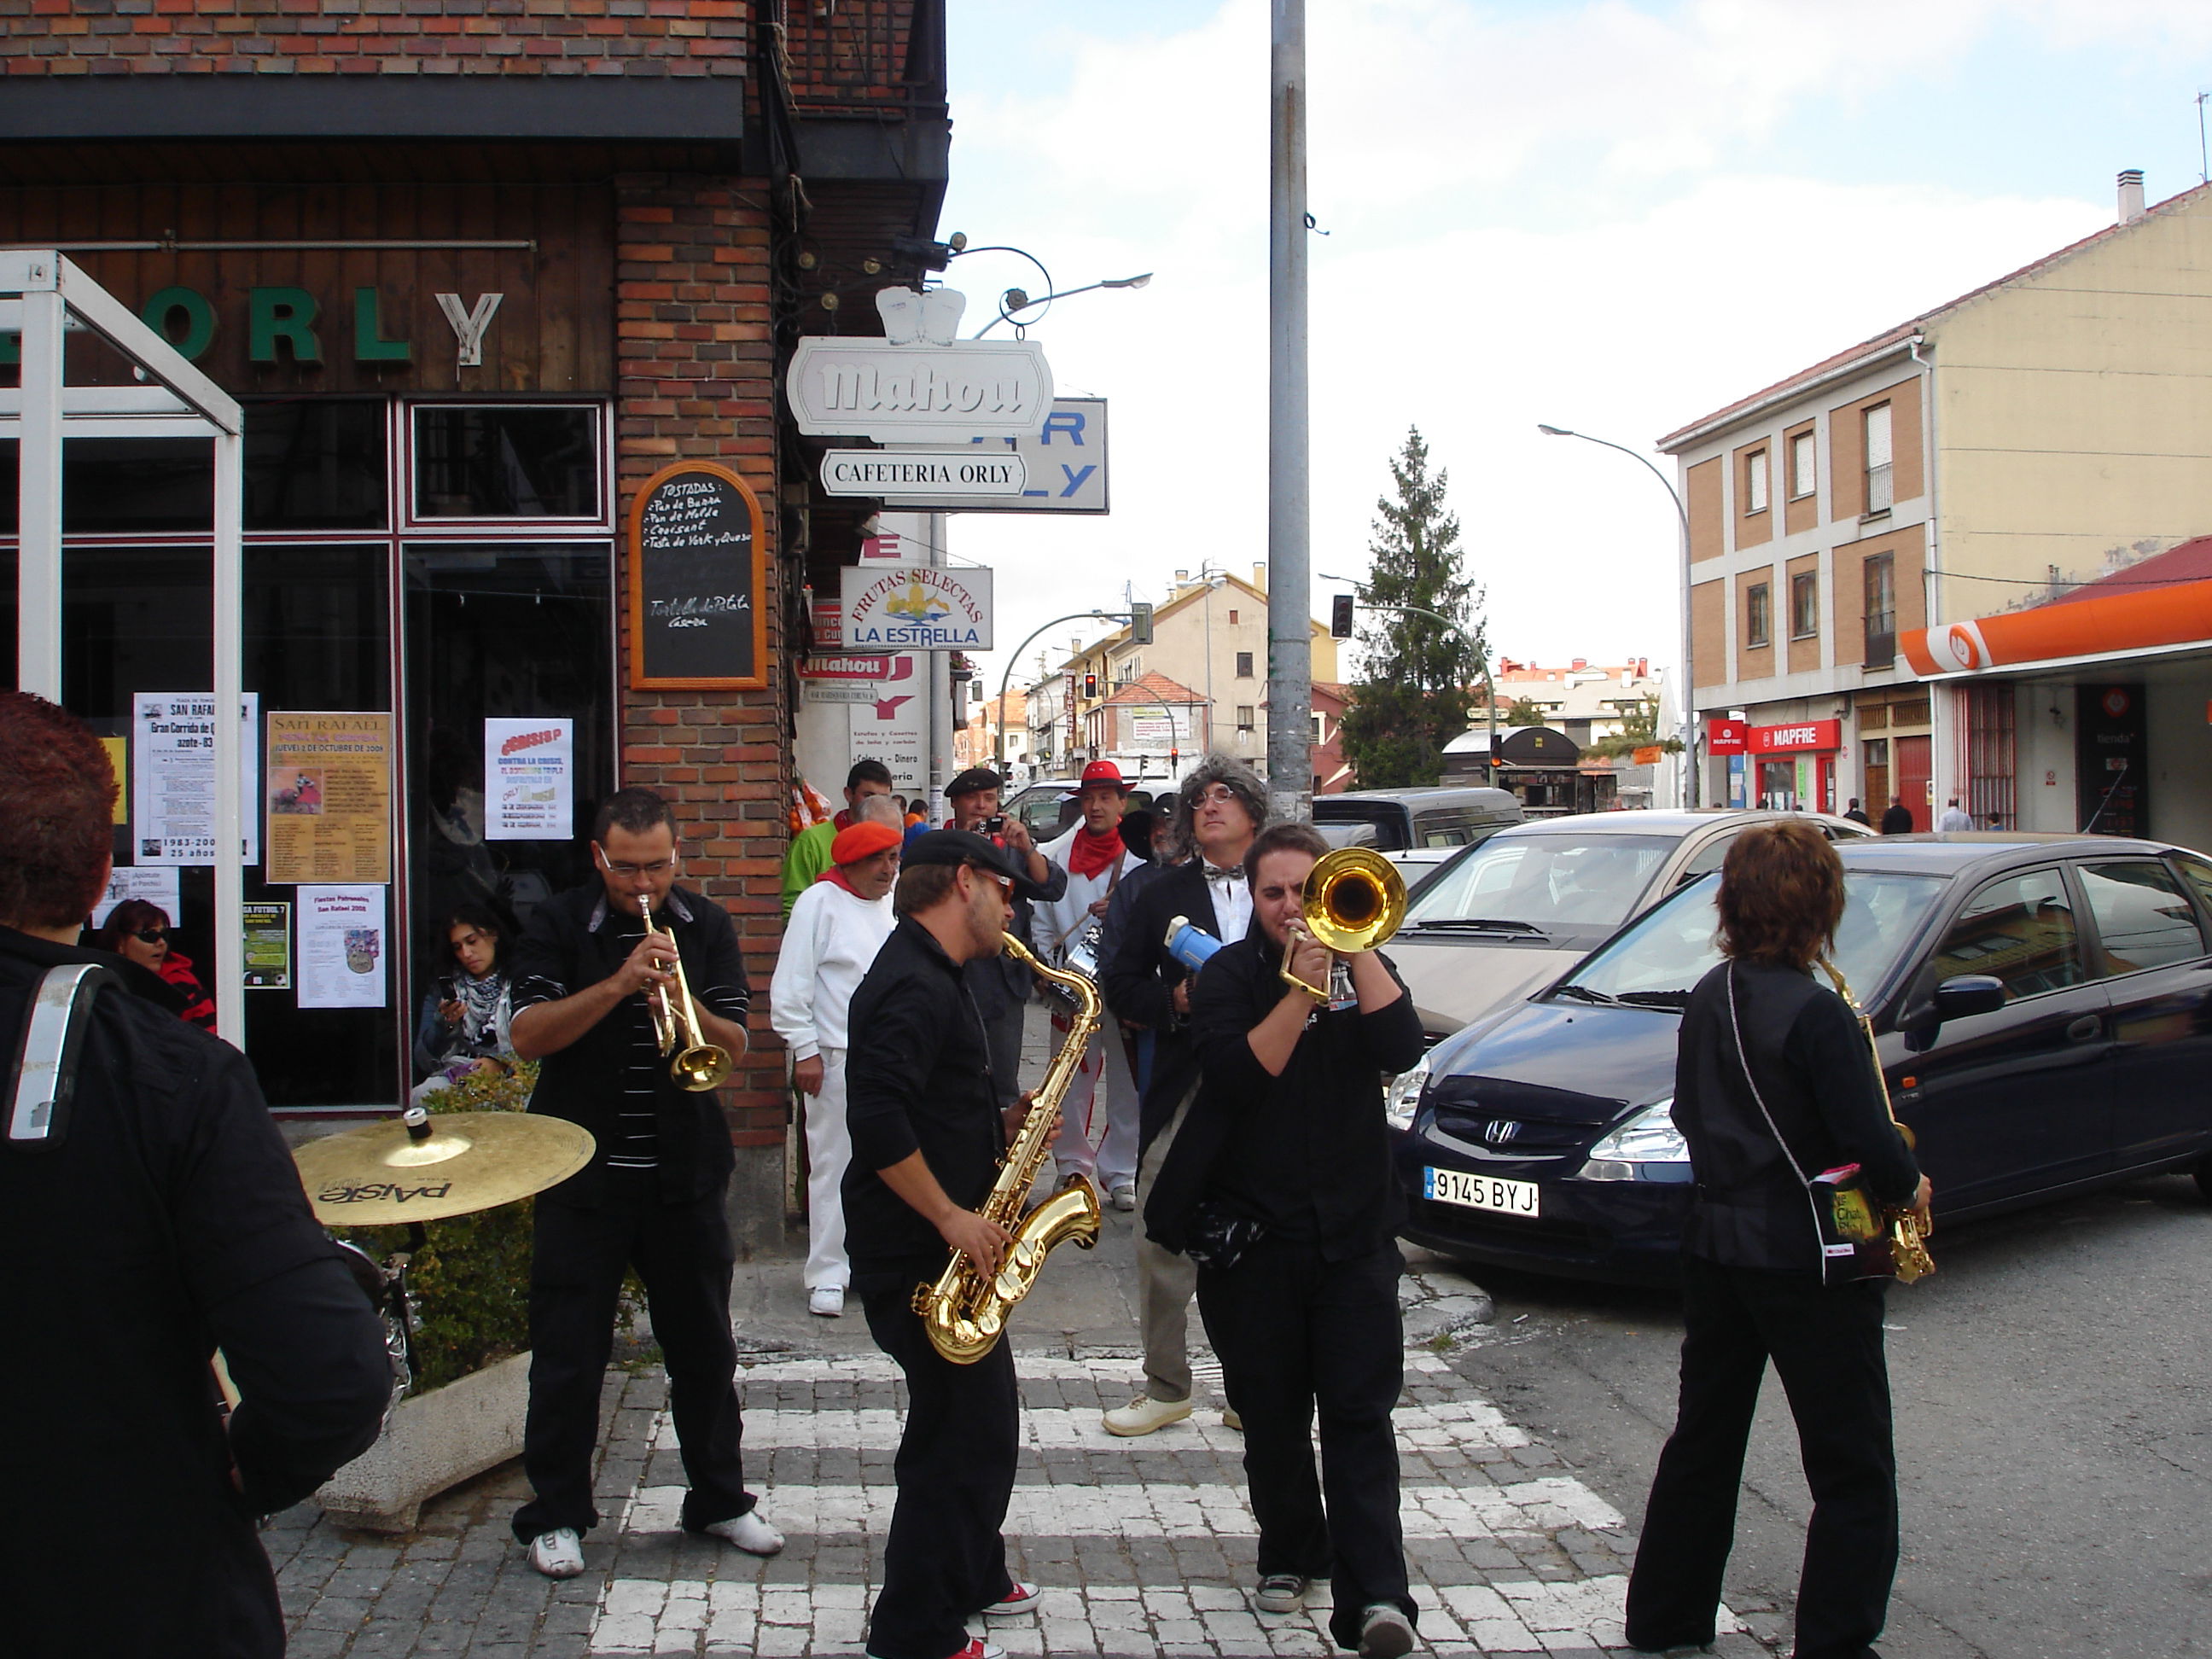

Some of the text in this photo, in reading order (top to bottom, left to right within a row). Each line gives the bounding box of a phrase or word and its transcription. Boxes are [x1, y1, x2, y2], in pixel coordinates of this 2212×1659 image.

[141, 285, 504, 367] ORLY
[818, 362, 1024, 413] Mahou
[835, 463, 1013, 484] CAFETERIA ORLY
[852, 568, 984, 624] FRUTAS SELECTAS
[854, 628, 980, 647] LA ESTRELLA
[802, 657, 881, 674] Mahou
[171, 704, 188, 716] SAN
[151, 722, 170, 734] Gran
[171, 722, 199, 734] Corrida
[201, 722, 210, 733] de
[1773, 727, 1817, 747] MAPFRE
[894, 754, 917, 763] Dinero
[1437, 1173, 1534, 1212] 9145 BYJ
